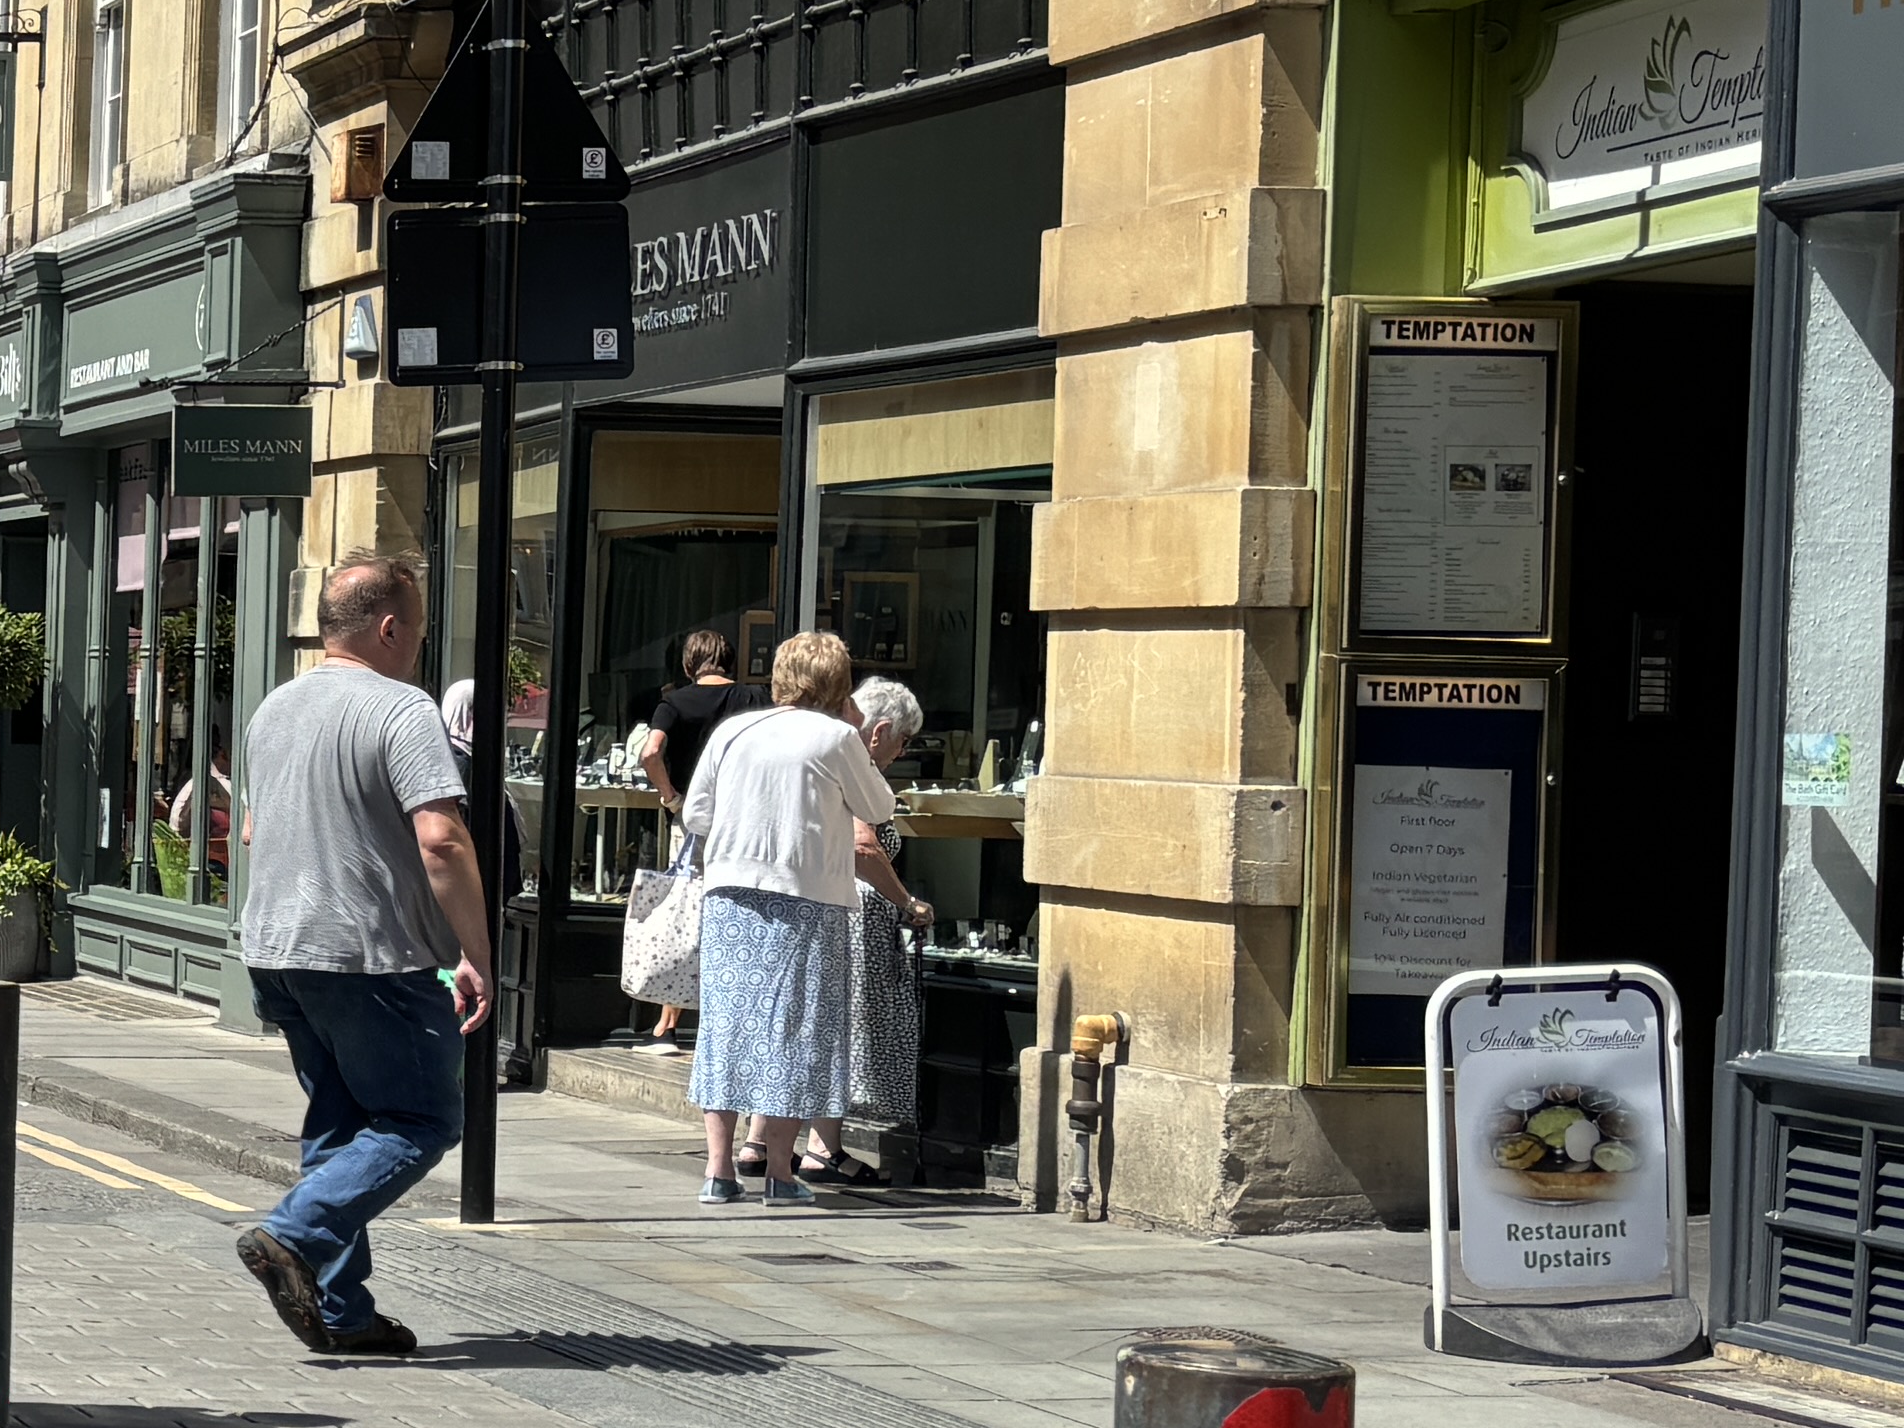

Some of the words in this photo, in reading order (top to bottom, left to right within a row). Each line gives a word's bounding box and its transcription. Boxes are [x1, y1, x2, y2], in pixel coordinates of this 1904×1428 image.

[1556, 74, 1642, 160] Indian
[1644, 150, 1673, 163] TASTE
[1678, 144, 1690, 157] OF
[1695, 136, 1731, 153] INDIAN
[675, 208, 774, 287] MANN
[1381, 319, 1535, 343] TEMPTATION
[70, 357, 116, 389] RESTAURANT
[115, 353, 134, 377] AND
[134, 348, 150, 373] BAR
[184, 439, 240, 453] MILES
[245, 439, 302, 453] MANN
[1367, 680, 1521, 705] TEMPTATION
[1400, 815, 1426, 827] First
[1390, 843, 1423, 856] Open
[1426, 844, 1434, 854] 7
[1436, 844, 1465, 858] Days
[1372, 871, 1411, 882] Indian
[1414, 872, 1478, 884] Vegetarian
[1364, 912, 1391, 924] Fully
[1394, 913, 1410, 922] Air
[1413, 914, 1486, 926] conditioned
[1382, 927, 1409, 939] Fully
[1400, 955, 1452, 966] Discount
[1466, 1026, 1535, 1053] Indian
[1569, 1028, 1646, 1050] Temptation
[1507, 1219, 1627, 1242] Restaurant
[1523, 1247, 1612, 1273] Upstairs
